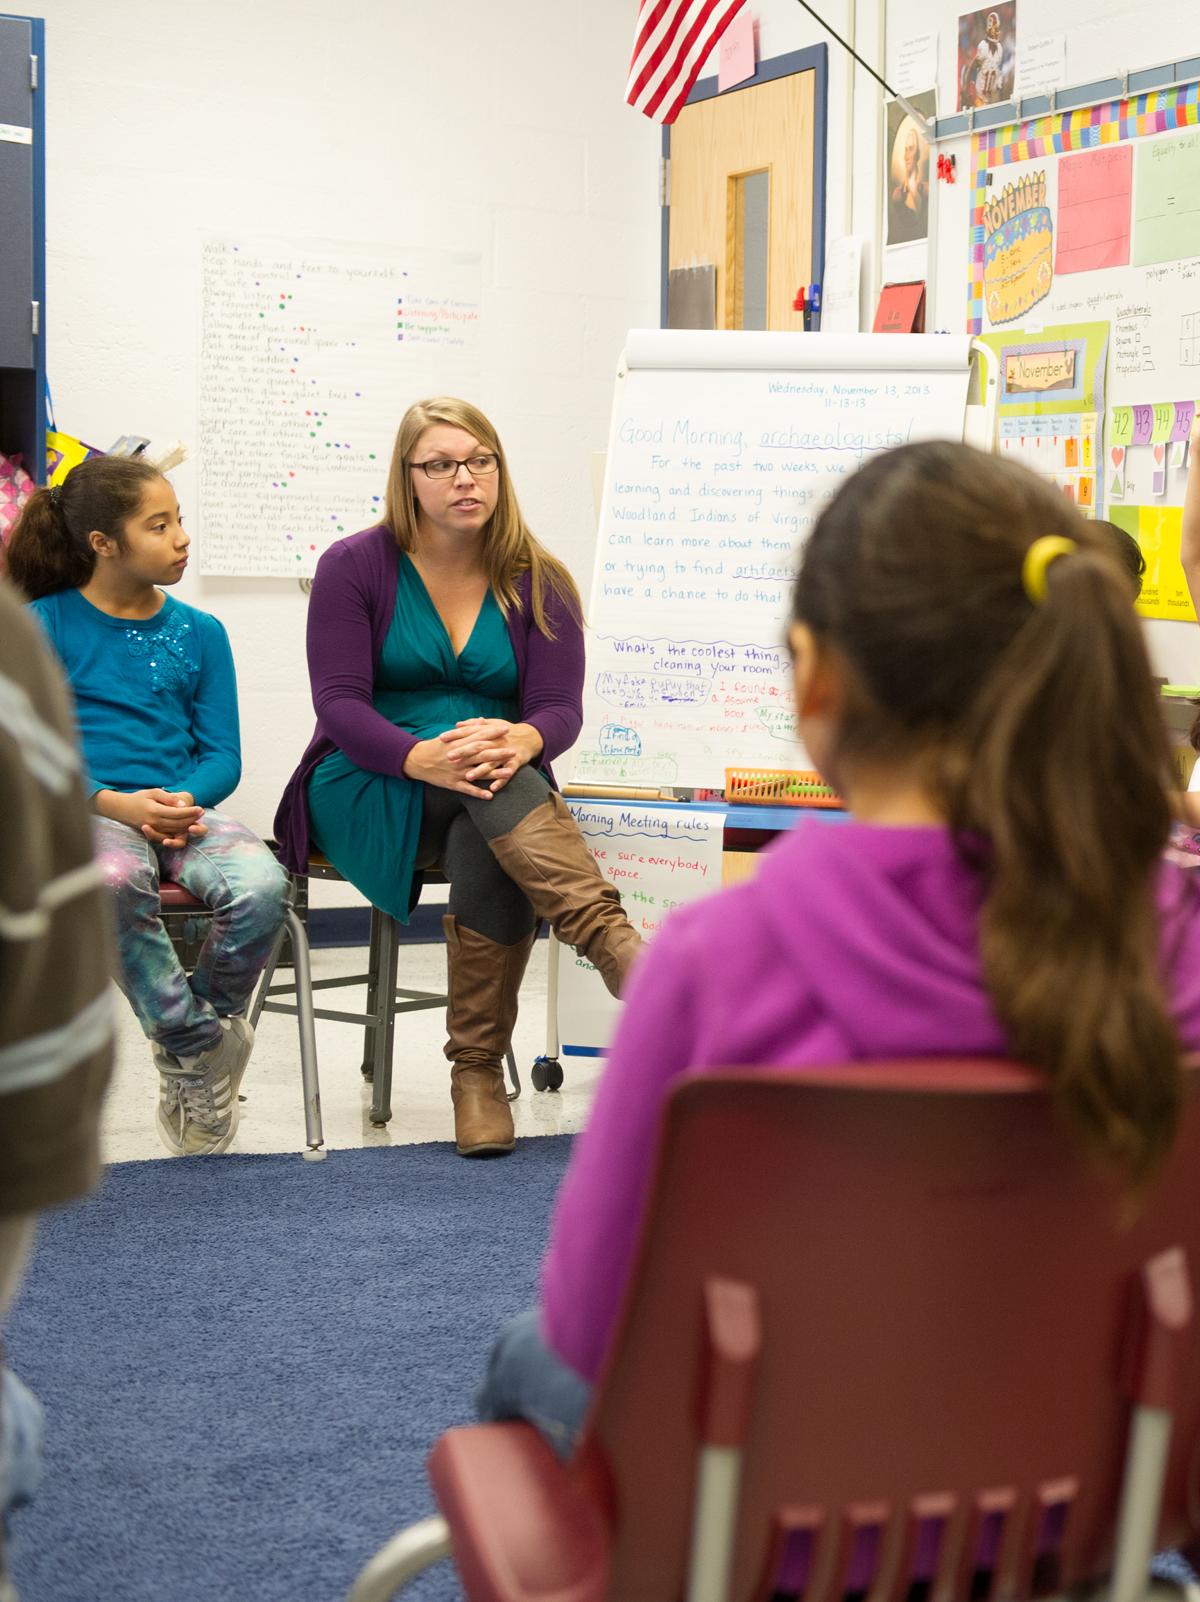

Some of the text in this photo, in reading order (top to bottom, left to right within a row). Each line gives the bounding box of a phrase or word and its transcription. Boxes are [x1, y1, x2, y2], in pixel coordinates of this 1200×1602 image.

[1152, 143, 1175, 161] Equality
[984, 183, 1045, 240] NOVEMBER
[1146, 268, 1168, 286] polygon
[1116, 304, 1151, 317] Quadrilaterals
[1116, 324, 1137, 333] rhombus
[1117, 351, 1138, 362] rectangle
[1019, 358, 1063, 379] November
[1116, 364, 1140, 377] trapezoid
[833, 385, 878, 395] November
[885, 385, 899, 398] 13,
[904, 386, 930, 395] 2013
[825, 398, 866, 408] 11-13-13
[1114, 412, 1129, 435] 42
[1136, 410, 1149, 435] 43
[1156, 410, 1169, 430] 44
[1177, 411, 1190, 432] 45
[620, 418, 662, 444] Good
[673, 420, 748, 457] Morning,
[652, 456, 670, 470] For
[682, 458, 701, 470] the
[714, 460, 742, 476] past
[753, 462, 773, 471] two
[782, 461, 818, 474] weeks,
[826, 463, 846, 473] we
[615, 482, 660, 502] learning
[669, 483, 690, 496] and
[699, 483, 762, 506] discovering
[773, 485, 813, 505] things
[613, 507, 676, 520] Woodland
[690, 508, 736, 522] Indians
[748, 511, 759, 522] of
[609, 534, 631, 544] can
[644, 532, 674, 547] learn
[681, 538, 710, 548] more
[719, 539, 752, 548] about
[761, 538, 790, 550] them
[605, 562, 616, 571] or
[624, 562, 665, 582] trying
[674, 561, 685, 573] to
[693, 561, 723, 574] find
[604, 584, 633, 597] have
[645, 589, 651, 597] a
[662, 587, 706, 599] chance
[715, 588, 728, 599] to
[735, 589, 748, 601] do
[614, 642, 780, 669] What's the coolest thing
[654, 658, 701, 675] cleaning
[711, 662, 736, 678] your
[720, 681, 766, 695] I found
[725, 708, 745, 718] book
[570, 807, 709, 838] Morning Meeting rules
[618, 852, 708, 876] sure everybody
[607, 866, 643, 881] space.
[632, 891, 655, 904] the
